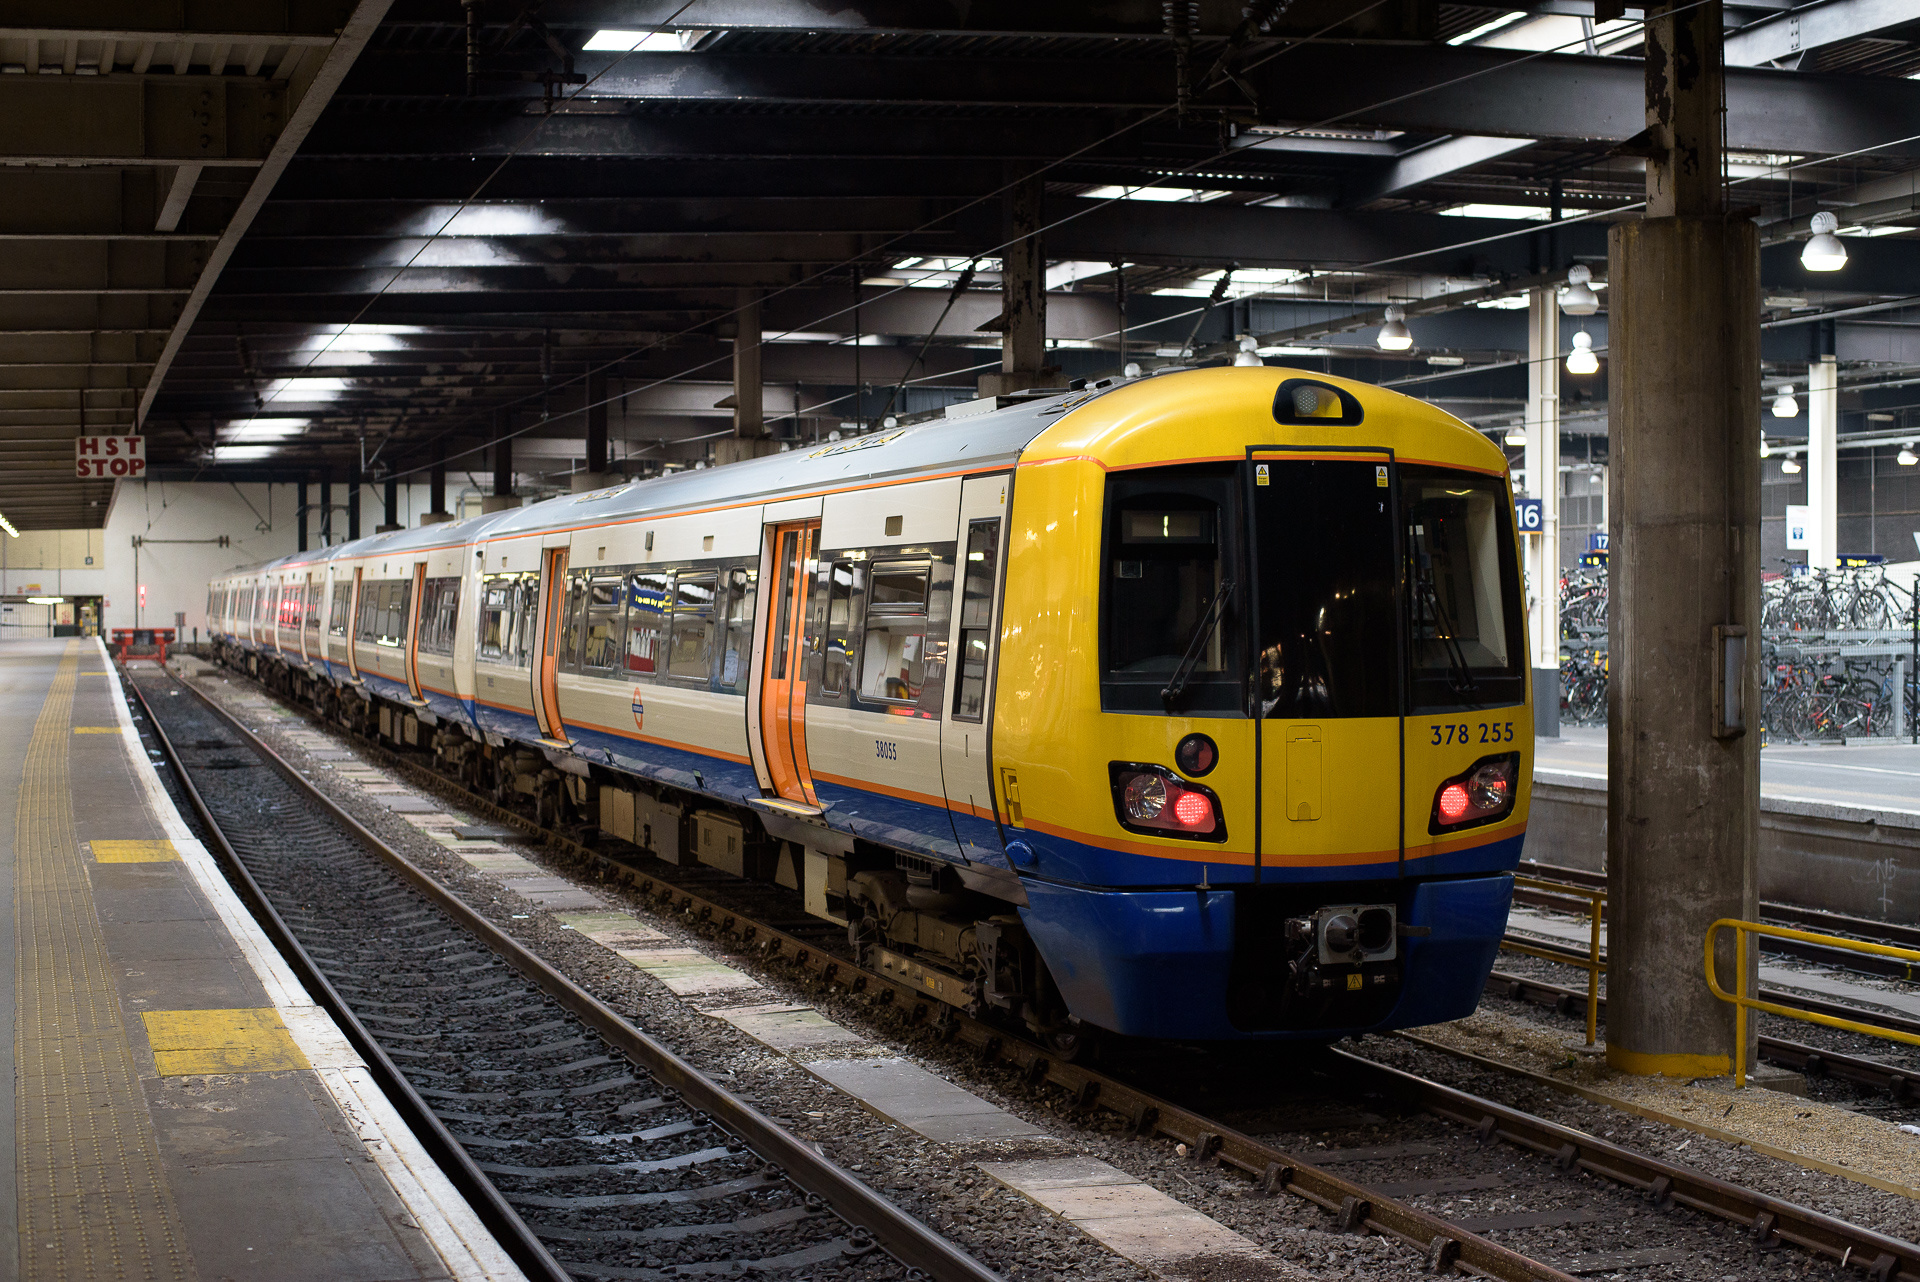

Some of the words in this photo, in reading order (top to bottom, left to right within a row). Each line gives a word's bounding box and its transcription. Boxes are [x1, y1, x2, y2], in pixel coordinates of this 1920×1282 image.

[77, 458, 145, 477] STOP
[1515, 504, 1540, 528] 16
[1597, 535, 1609, 549] 17
[1430, 724, 1469, 746] 378
[1478, 722, 1514, 743] 255
[875, 739, 897, 761] 38055
